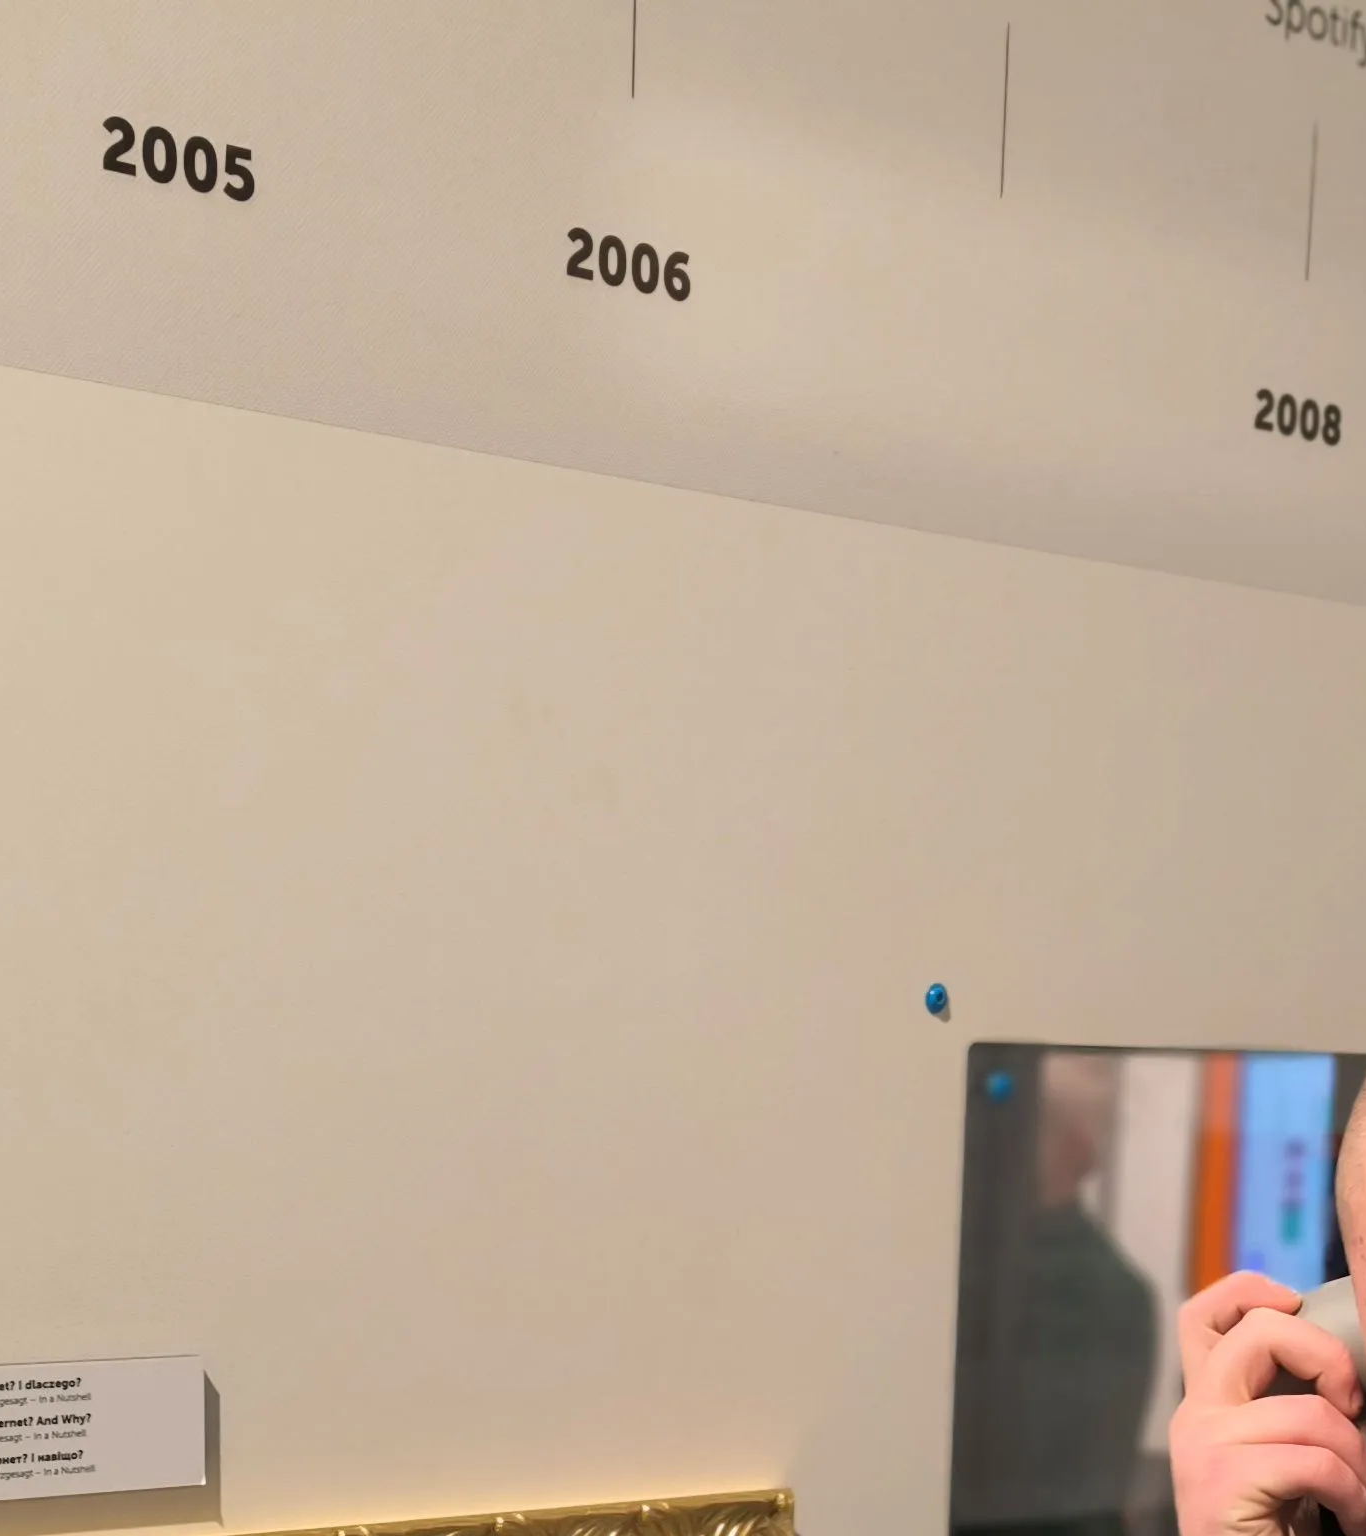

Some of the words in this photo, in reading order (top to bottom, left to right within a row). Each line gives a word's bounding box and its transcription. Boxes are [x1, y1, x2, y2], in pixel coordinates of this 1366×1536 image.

[102, 116, 255, 202] 2005
[566, 227, 691, 302] 2006
[1254, 387, 1342, 446] 2008
[25, 1377, 82, 1390] dlaczego?
[36, 1415, 58, 1426] And
[61, 1413, 92, 1426] Why?
